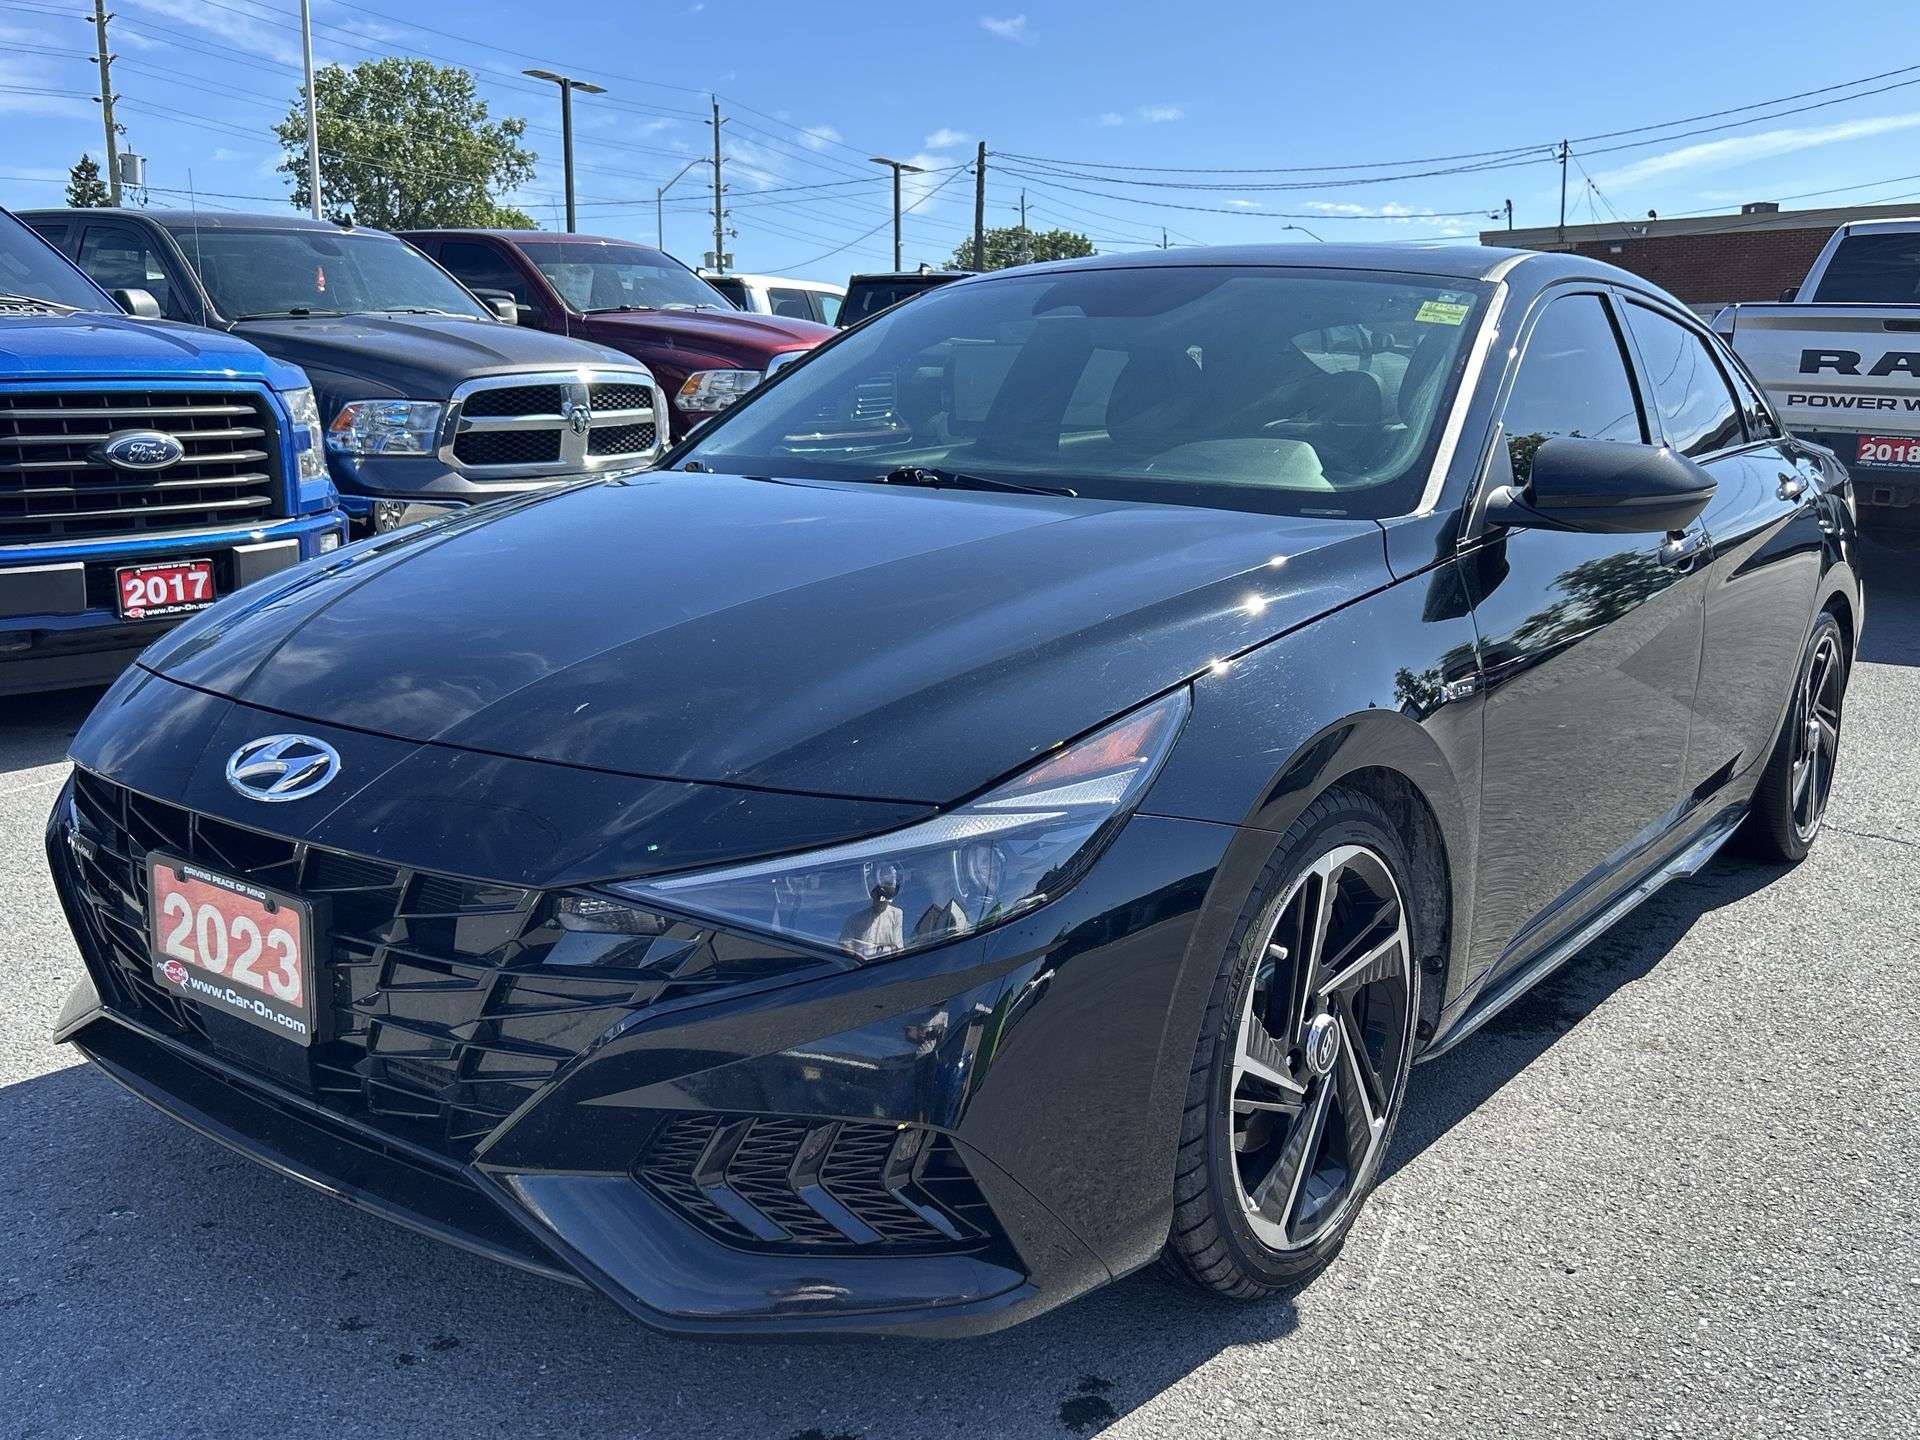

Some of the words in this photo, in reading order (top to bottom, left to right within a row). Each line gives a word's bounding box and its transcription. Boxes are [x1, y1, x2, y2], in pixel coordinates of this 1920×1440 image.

[1787, 394, 1897, 411] POWER
[128, 442, 167, 462] Ford
[1860, 443, 1920, 463] 2018
[126, 571, 208, 607] 2017
[184, 866, 212, 881] DRIVING
[212, 876, 235, 889] PEACE
[236, 883, 246, 892] OF
[247, 887, 266, 900] MIND
[163, 892, 300, 1000] 2023
[190, 977, 306, 1034] www.Car-On.com
